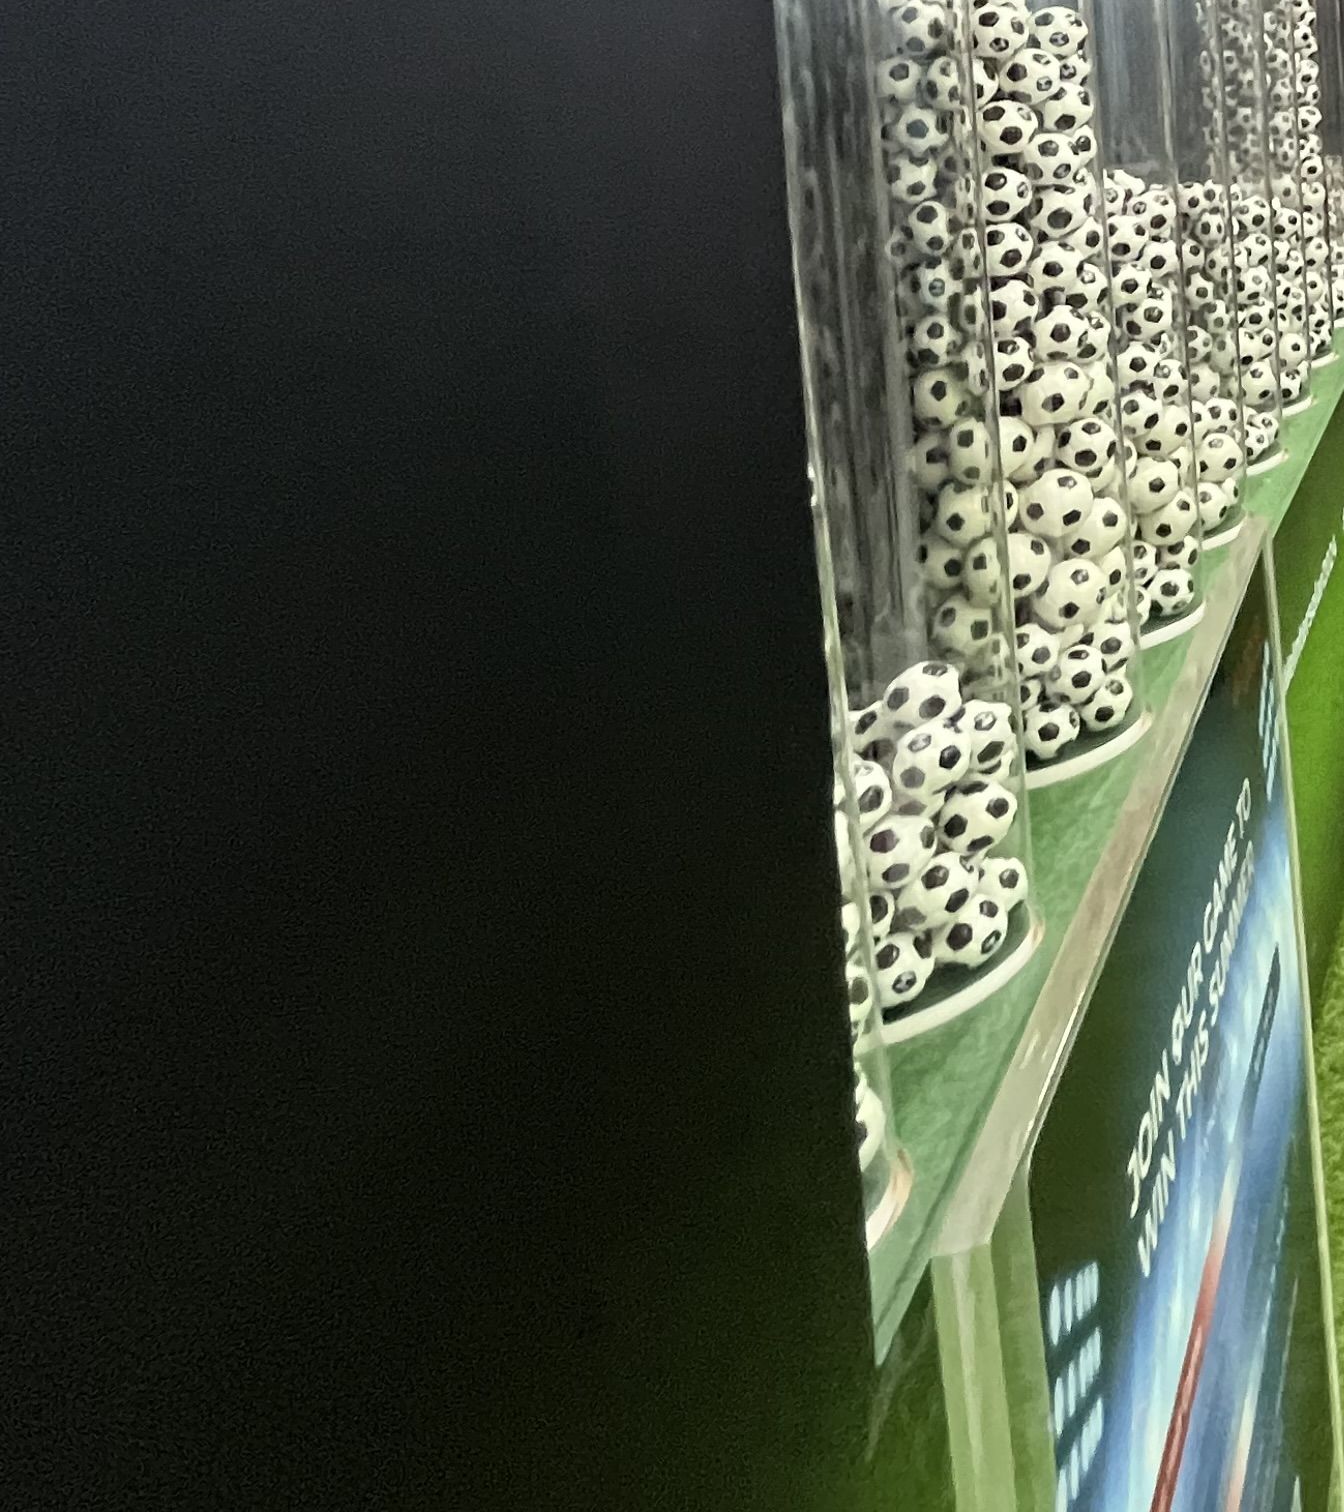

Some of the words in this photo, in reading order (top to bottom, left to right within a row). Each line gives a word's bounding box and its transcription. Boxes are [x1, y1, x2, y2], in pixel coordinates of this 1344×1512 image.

[1127, 1048, 1171, 1220] JOIN
[1172, 941, 1204, 1065] OUR
[1203, 821, 1238, 954] GAME
[1236, 777, 1252, 840] TO
[1138, 1127, 1176, 1278] WIN
[1176, 1009, 1209, 1141] THIS
